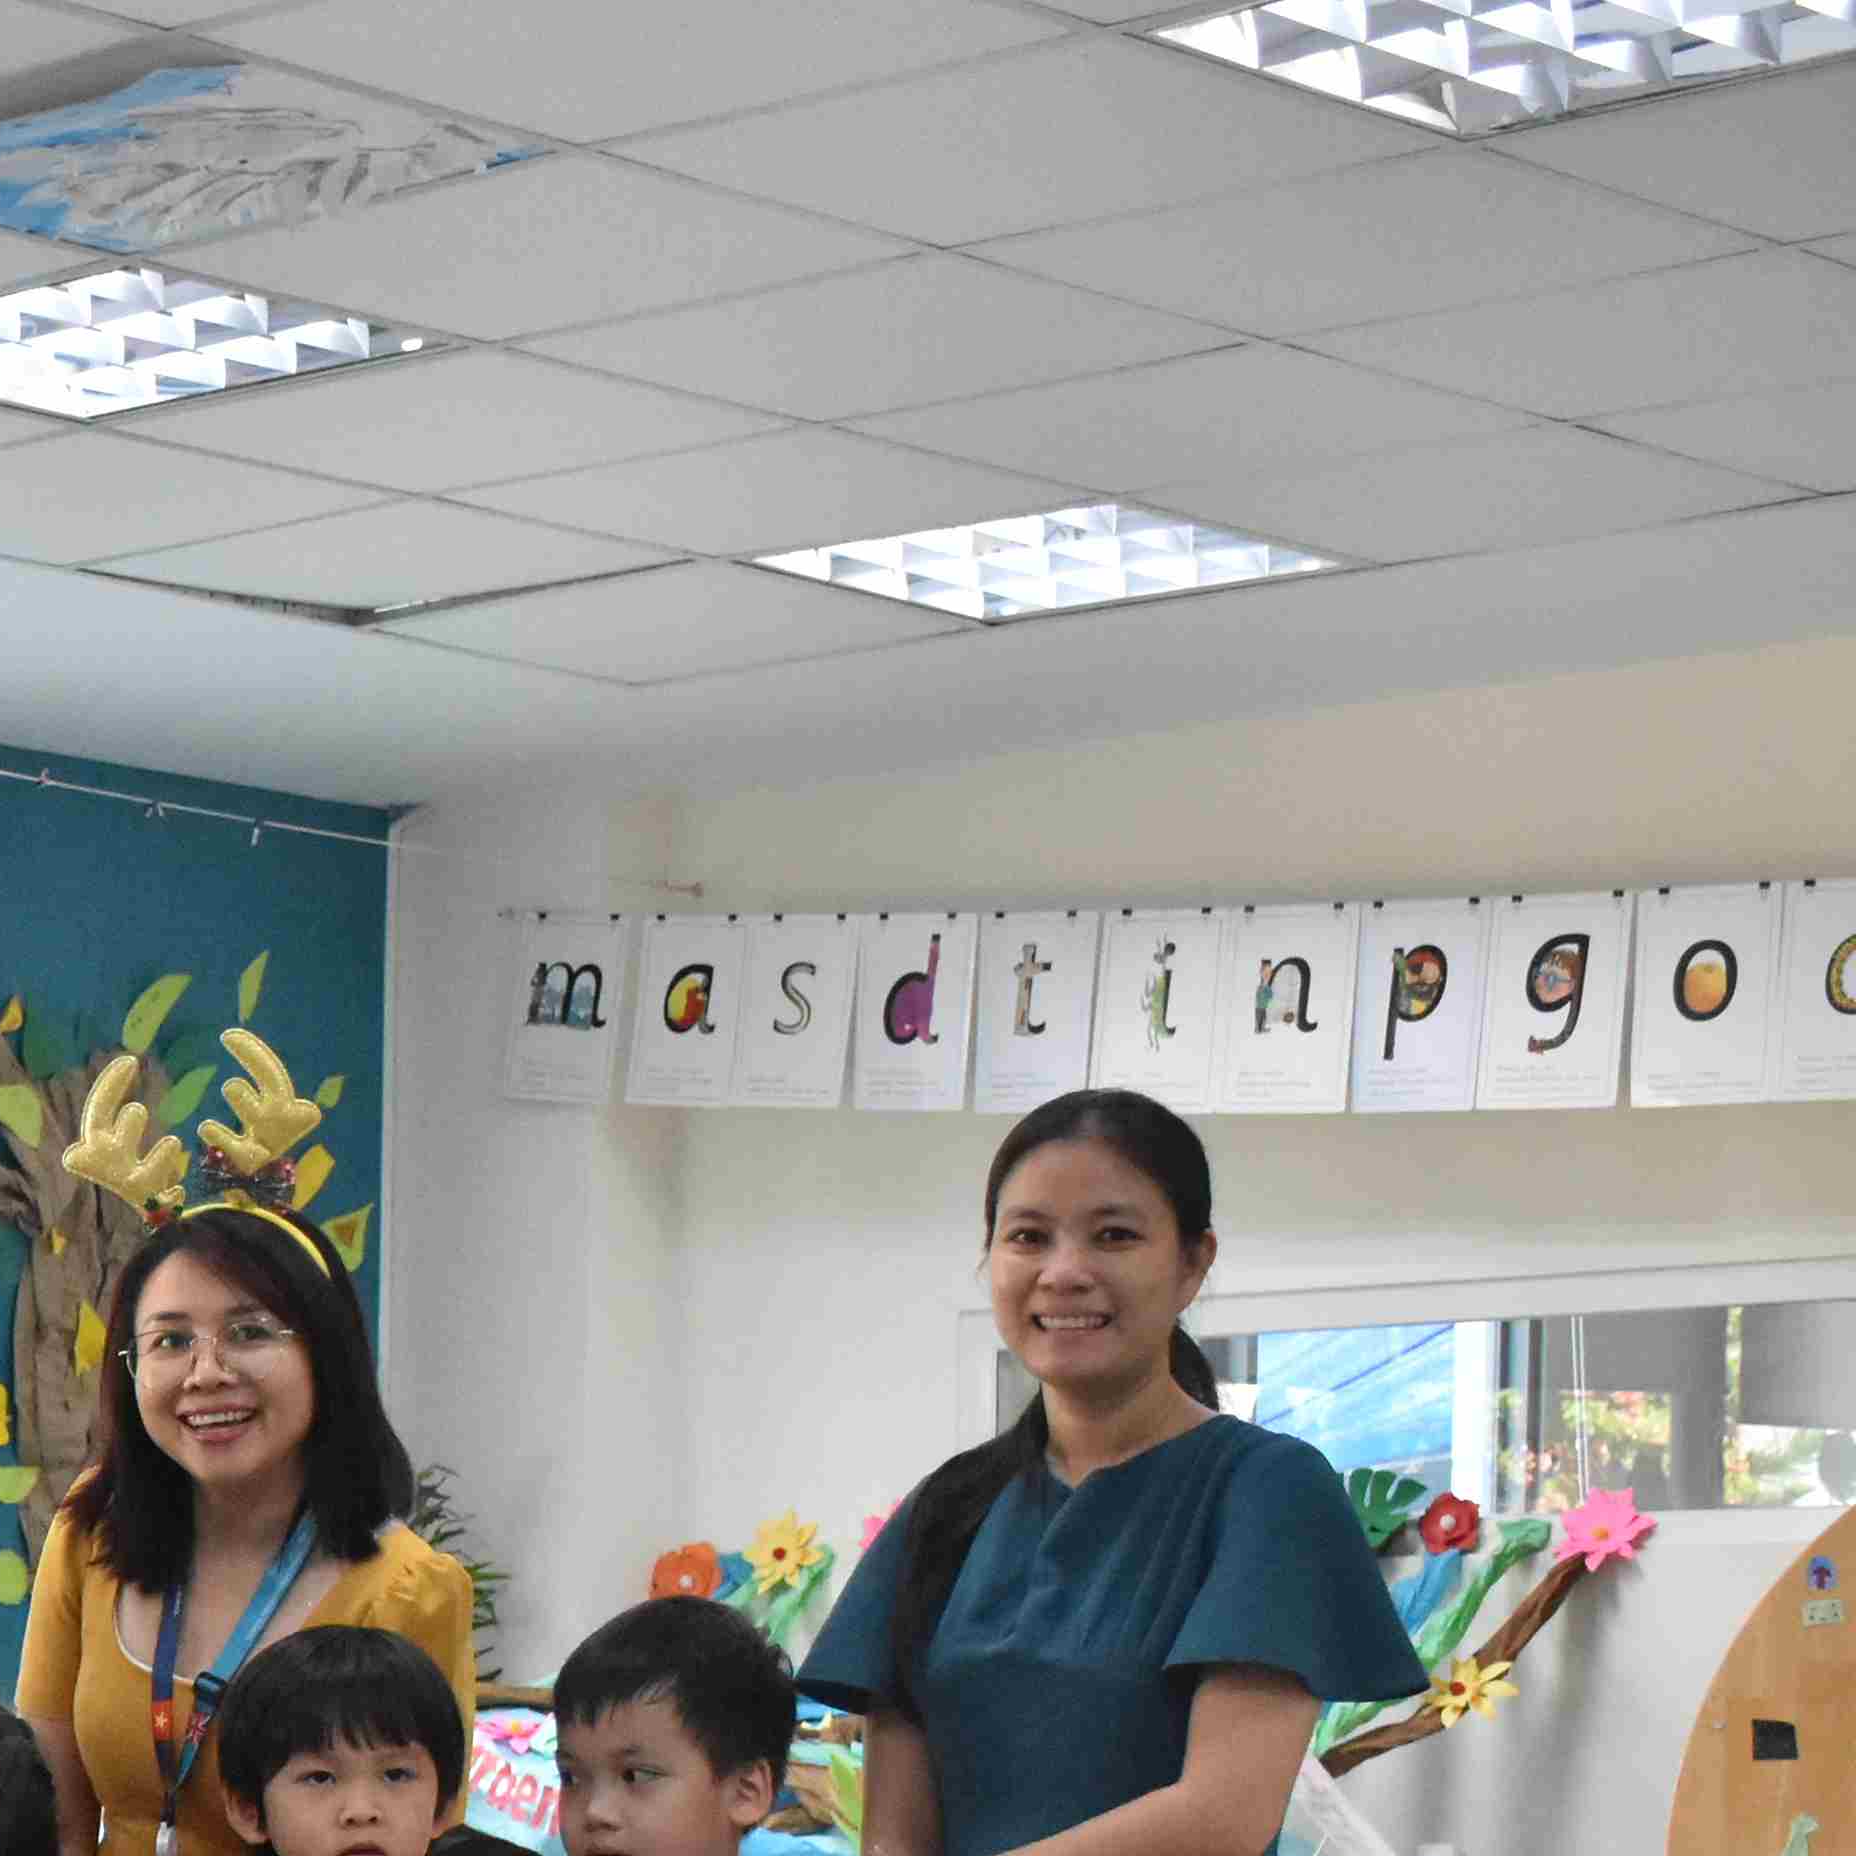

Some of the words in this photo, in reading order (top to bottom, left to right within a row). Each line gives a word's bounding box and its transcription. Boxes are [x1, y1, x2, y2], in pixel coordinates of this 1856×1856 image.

[525, 961, 607, 1031] m
[663, 963, 715, 1035] a
[773, 961, 817, 1035] s
[883, 932, 940, 1045] d
[1013, 942, 1052, 1037] t
[1253, 956, 1319, 1034] n
[1383, 943, 1448, 1061] p
[1526, 932, 1591, 1054] g
[1672, 939, 1738, 1022] o
